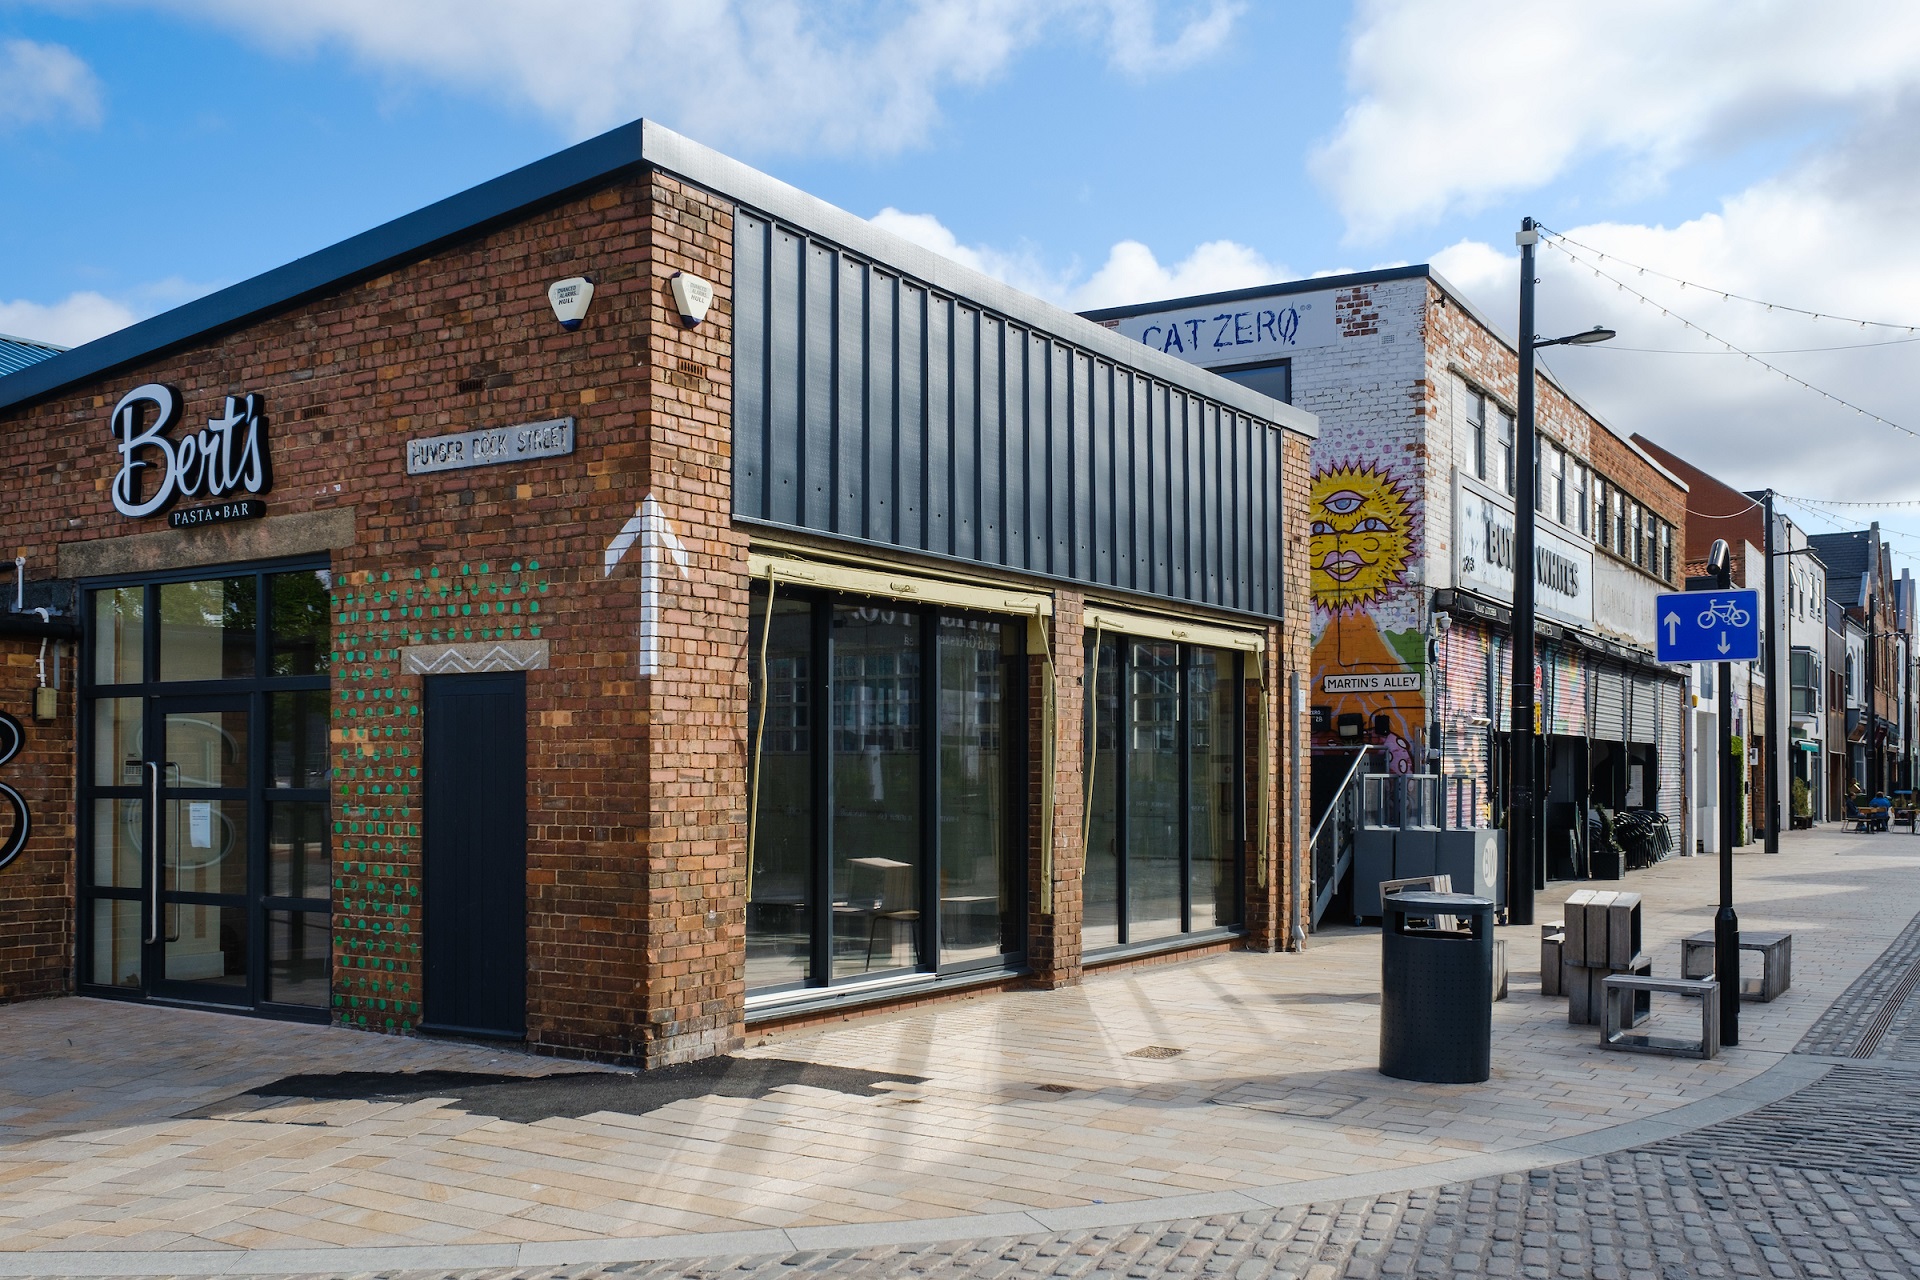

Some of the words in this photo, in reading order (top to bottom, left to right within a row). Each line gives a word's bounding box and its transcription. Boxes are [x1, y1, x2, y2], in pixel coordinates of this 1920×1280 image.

[1143, 319, 1206, 353] CAT
[111, 383, 262, 518] Bert's
[472, 433, 508, 459] DOCK
[517, 425, 567, 453] STREET
[174, 509, 212, 525] PASTA
[223, 503, 249, 518] BAR
[1486, 521, 1515, 573] BUT
[1536, 545, 1579, 599] WHITES
[1327, 678, 1379, 689] MARTIN'S
[1383, 677, 1416, 687] ALLEY
